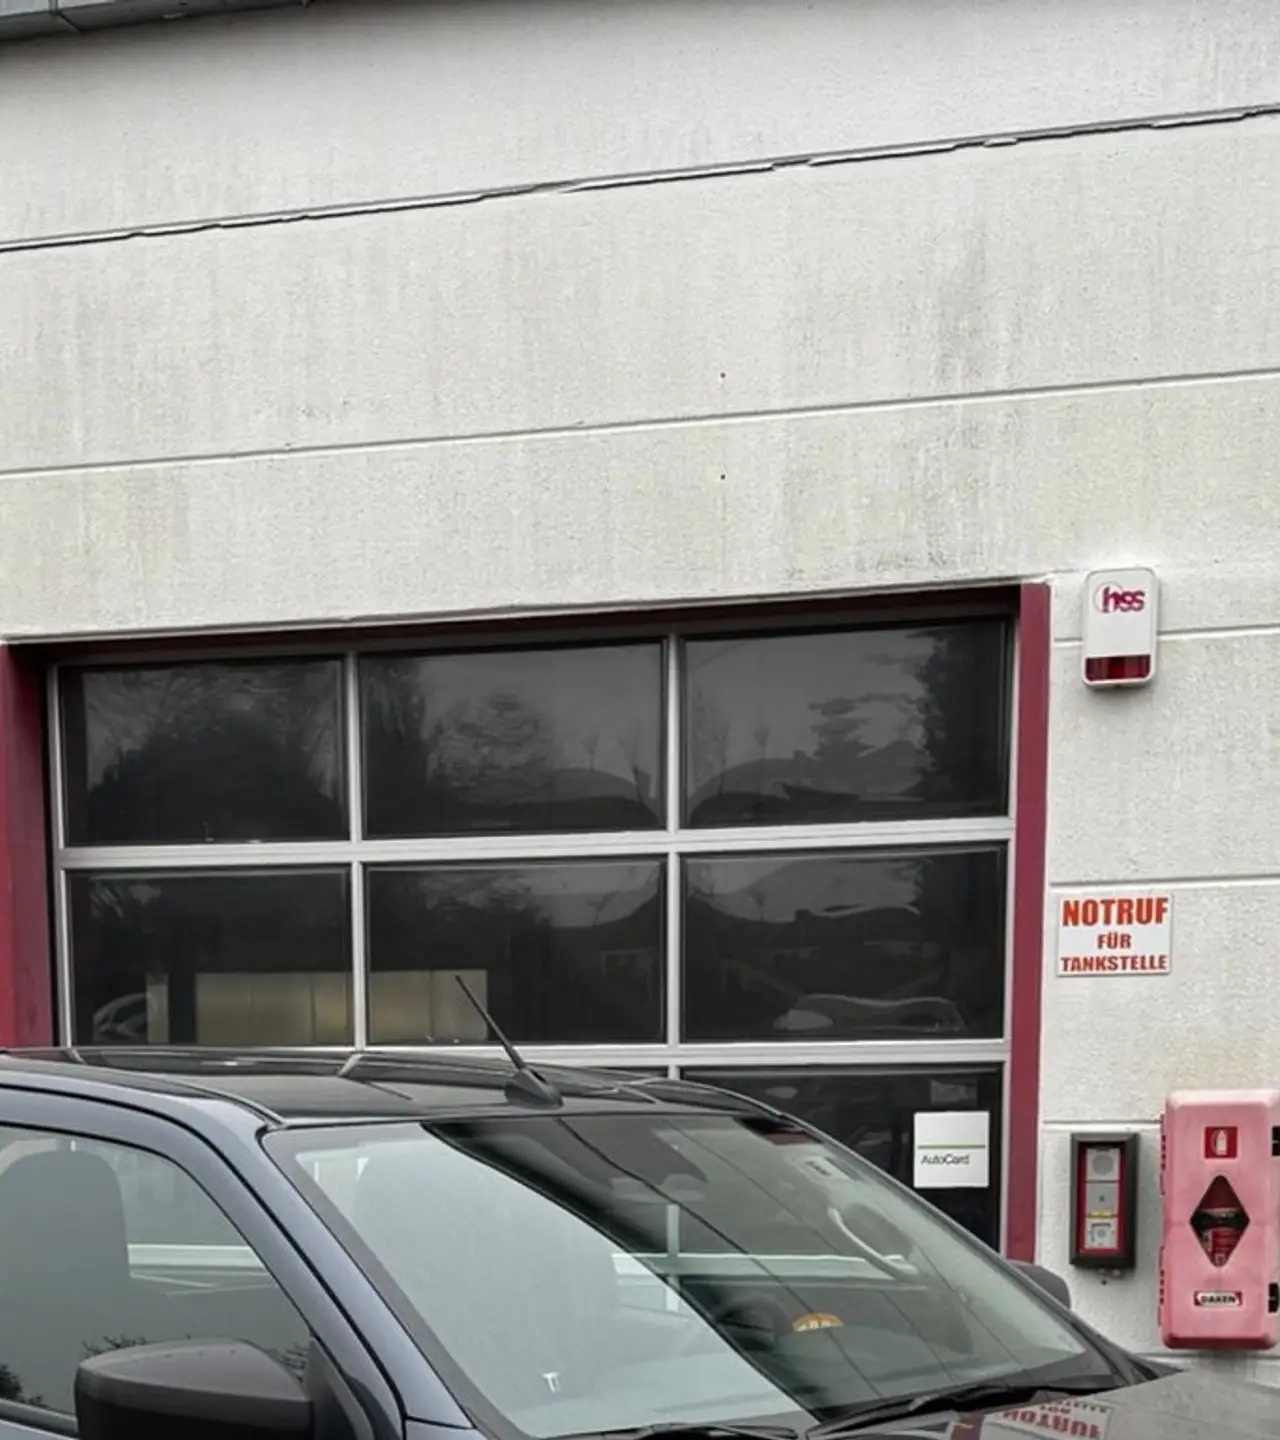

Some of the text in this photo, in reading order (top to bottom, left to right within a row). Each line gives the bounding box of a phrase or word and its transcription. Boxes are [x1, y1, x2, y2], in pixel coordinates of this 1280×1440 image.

[1102, 585, 1146, 613] hss
[1062, 897, 1169, 927] NOTRUF
[1097, 931, 1132, 950] FÜR
[1061, 954, 1167, 972] TANKSTELLE
